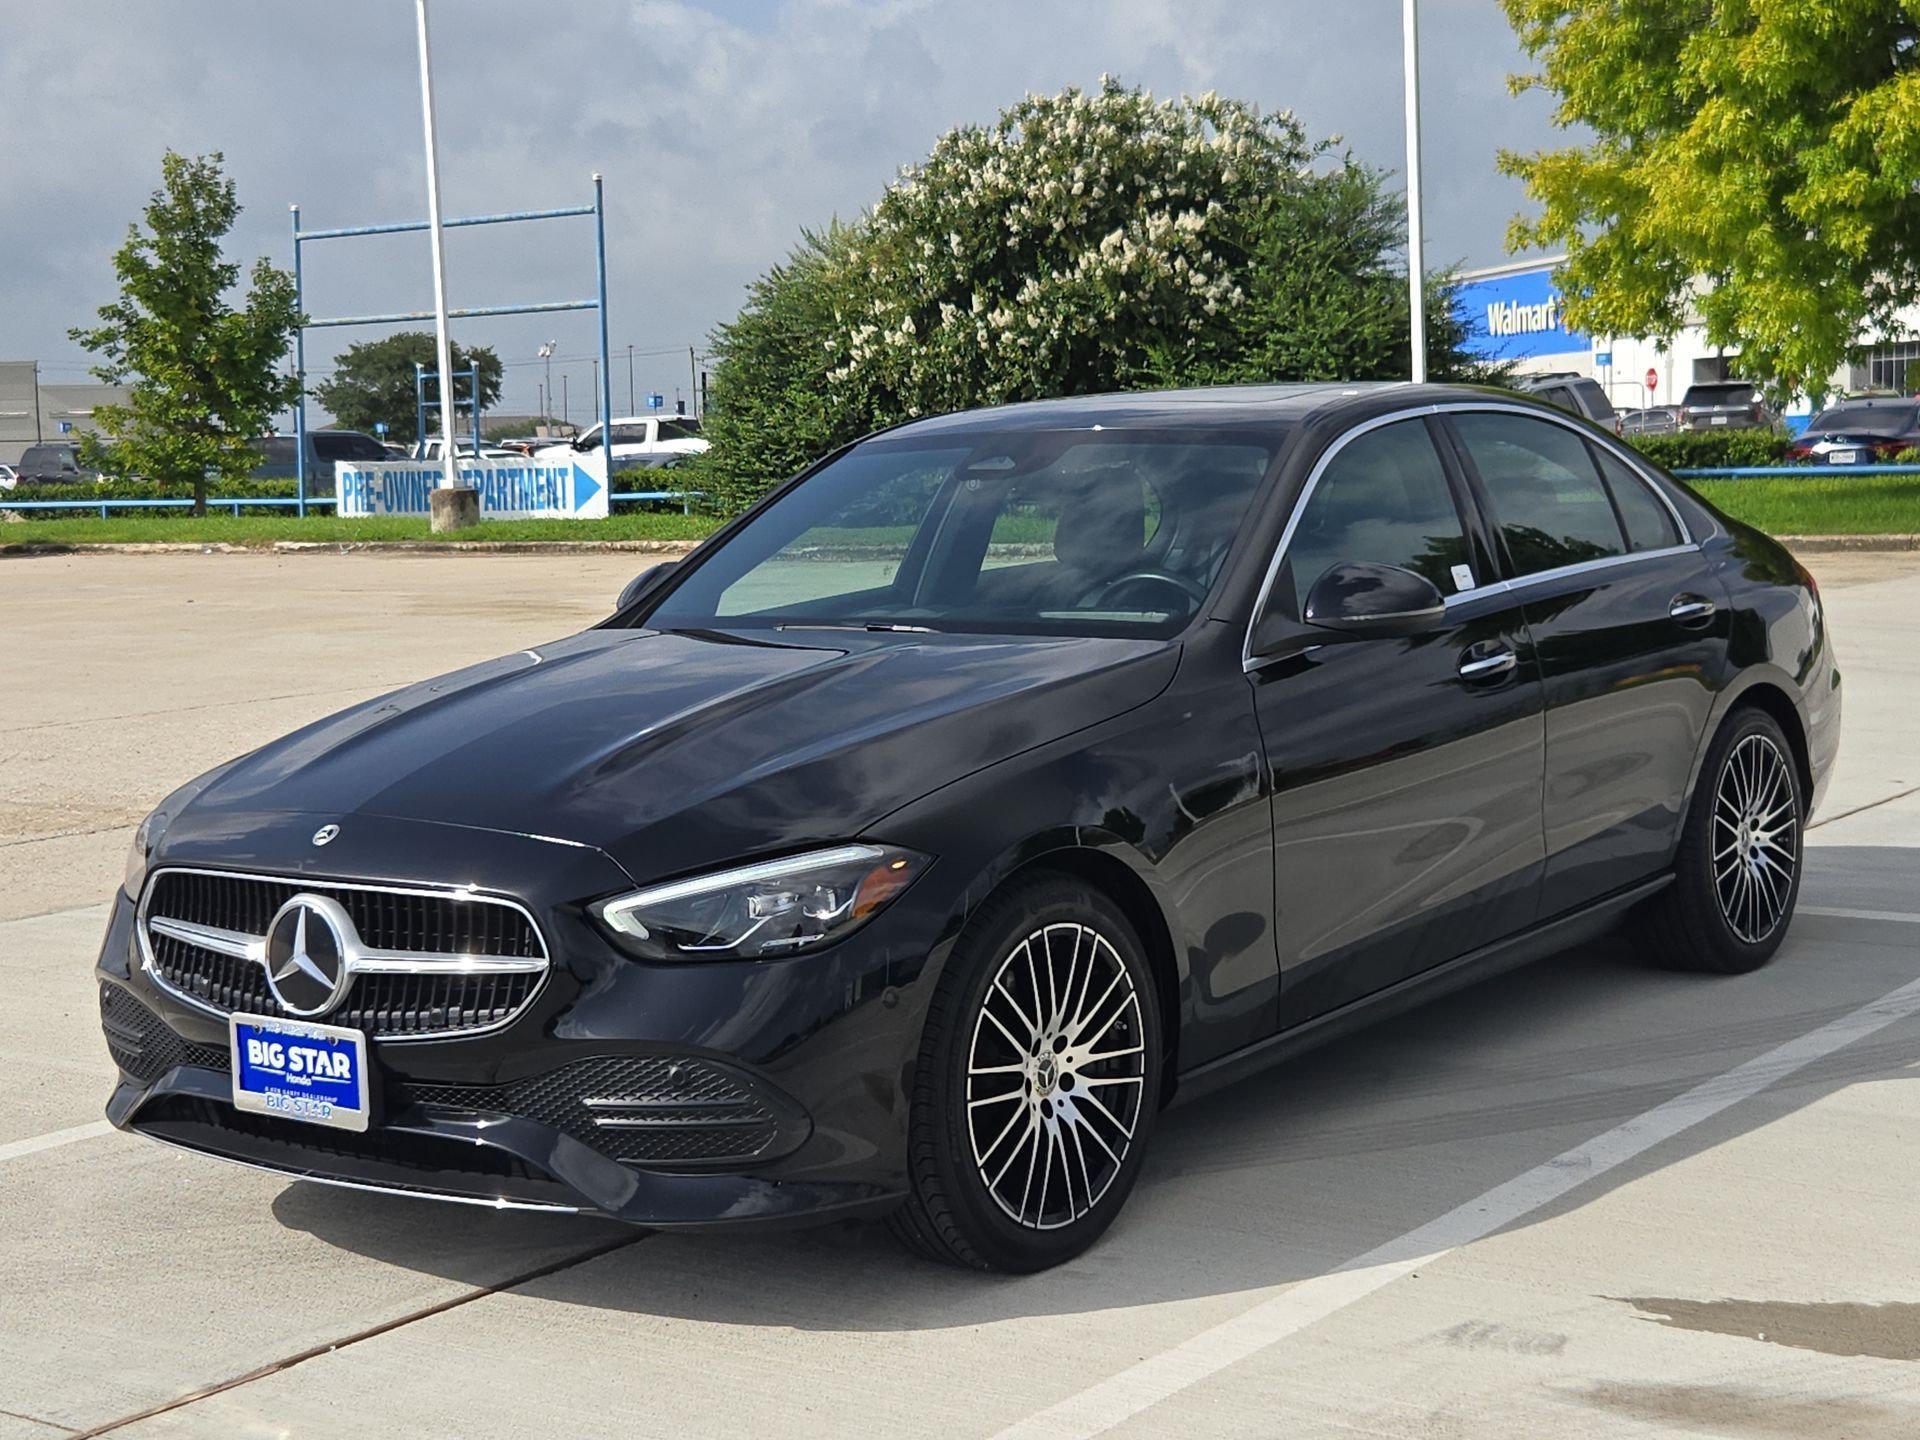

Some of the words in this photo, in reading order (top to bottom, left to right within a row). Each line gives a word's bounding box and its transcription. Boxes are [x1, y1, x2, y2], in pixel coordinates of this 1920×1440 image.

[1487, 294, 1556, 336] Walmart
[457, 468, 568, 511] PARTMENT
[247, 1038, 285, 1069] BIG
[288, 1045, 351, 1078] STAR
[266, 1094, 290, 1110] BIG
[294, 1099, 333, 1118] STAR
